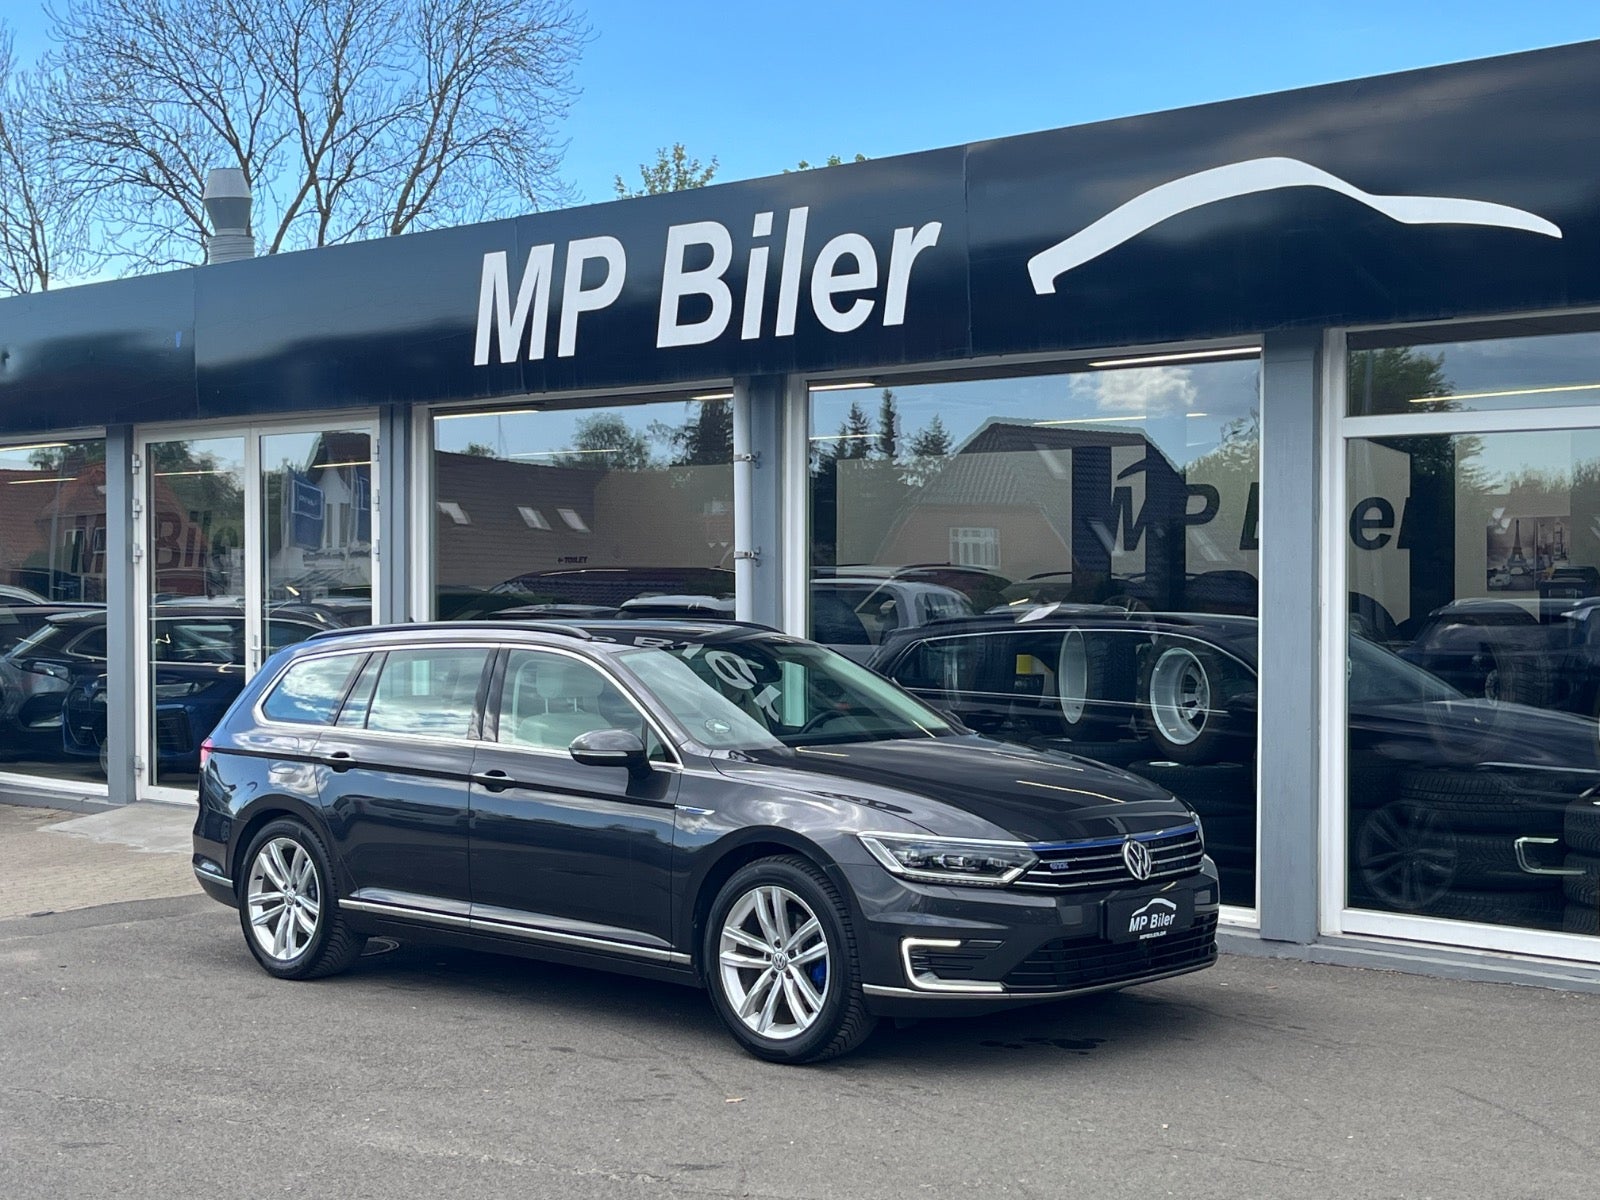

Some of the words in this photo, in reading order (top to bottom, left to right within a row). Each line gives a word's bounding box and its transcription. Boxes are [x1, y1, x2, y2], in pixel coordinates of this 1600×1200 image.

[474, 235, 627, 366] MP
[656, 206, 942, 348] Biler
[1128, 915, 1148, 932] MP
[1150, 912, 1176, 929] Biler
